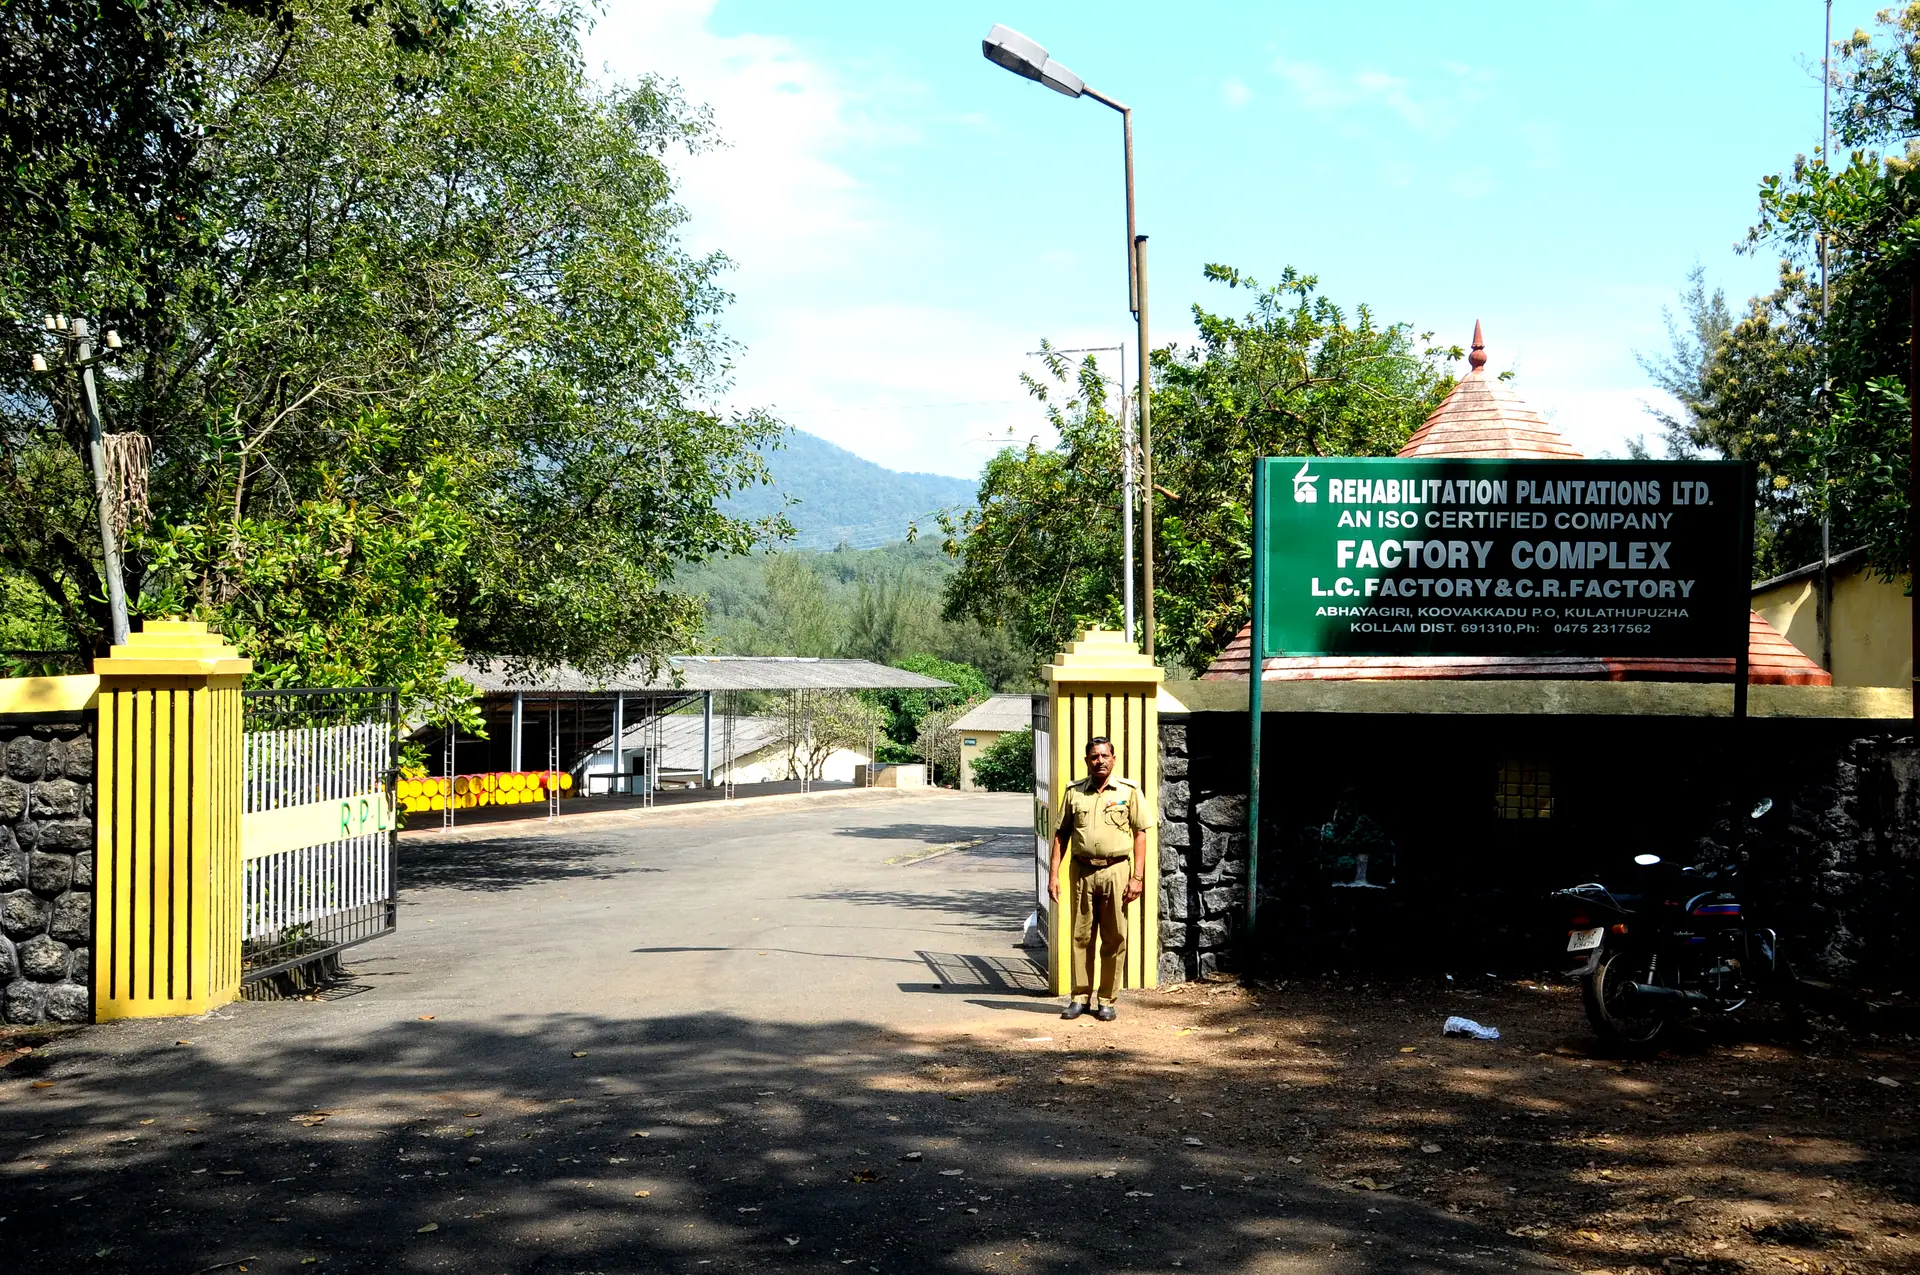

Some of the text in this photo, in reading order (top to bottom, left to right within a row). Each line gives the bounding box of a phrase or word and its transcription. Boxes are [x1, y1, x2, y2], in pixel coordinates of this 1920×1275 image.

[1328, 478, 1714, 506] REHABILITATION PLANTATIONS LTD.
[1336, 509, 1673, 530] AN ISO CERTIFIED COMPANY
[1336, 539, 1672, 570] FACTORY COMPLEX
[1315, 606, 1413, 618] ABHAYAGIRI,
[1418, 607, 1527, 618] KOOVAKKADU
[1564, 608, 1689, 618] KULATHUPUZHA
[1350, 622, 1416, 633] KOLLAM
[1420, 623, 1456, 633] DIST.
[1554, 624, 1588, 633] 0475
[1592, 624, 1651, 634] 2317562
